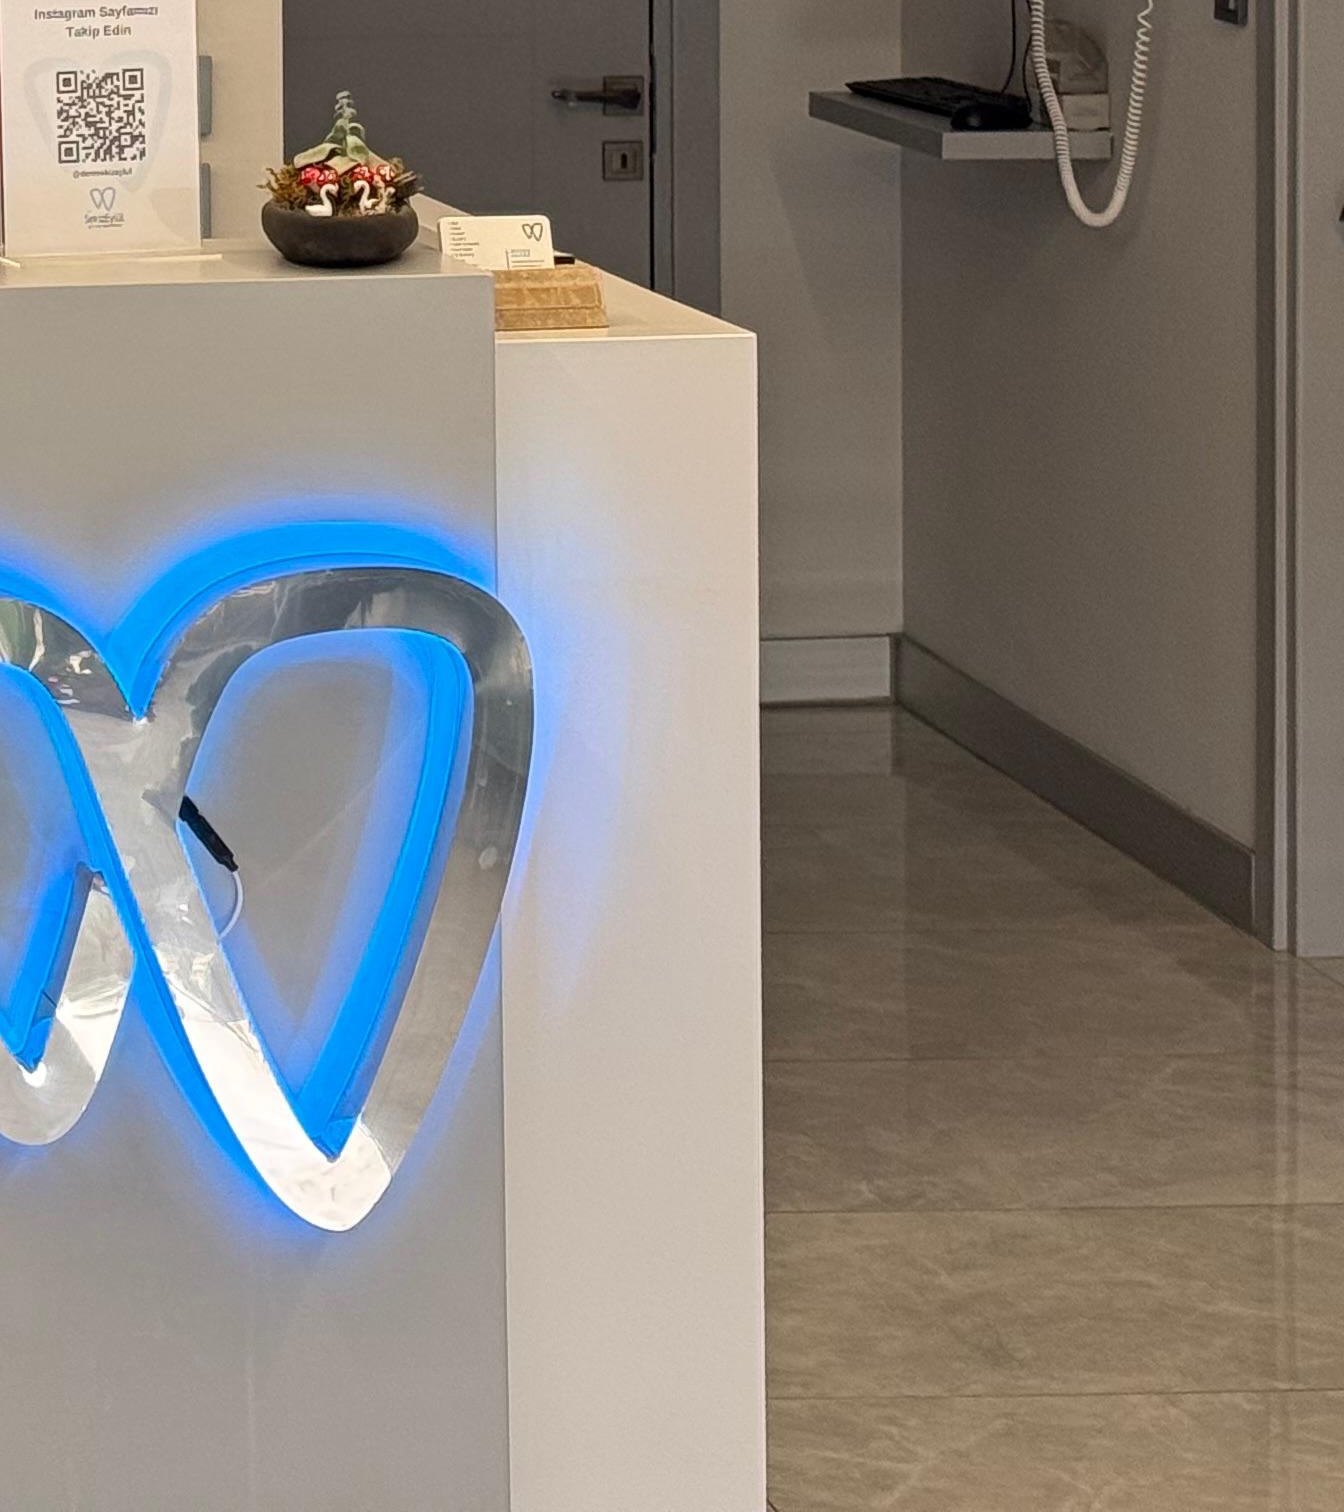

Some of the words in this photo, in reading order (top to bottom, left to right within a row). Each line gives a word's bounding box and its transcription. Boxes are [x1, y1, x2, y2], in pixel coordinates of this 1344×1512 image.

[34, 9, 96, 21] Instagram
[65, 24, 100, 40] Takip
[103, 25, 132, 36] Edin
